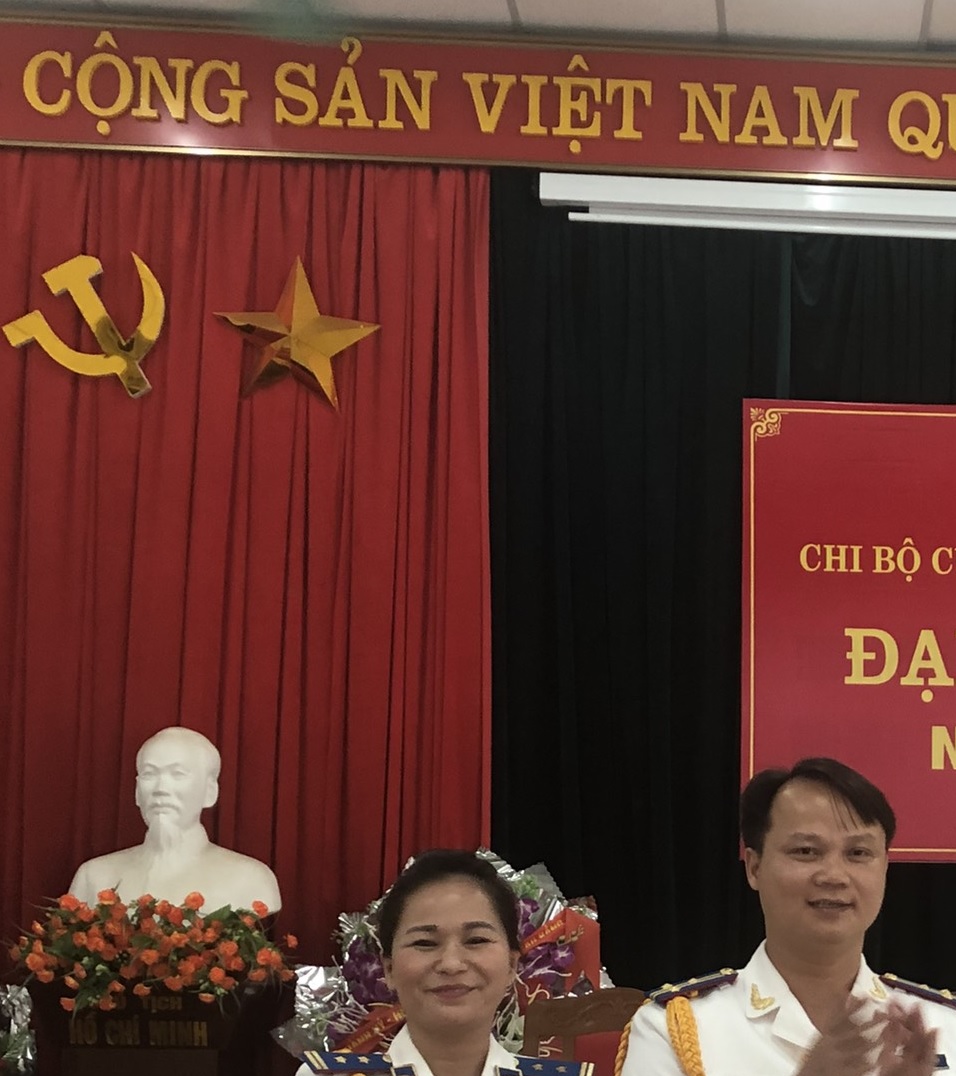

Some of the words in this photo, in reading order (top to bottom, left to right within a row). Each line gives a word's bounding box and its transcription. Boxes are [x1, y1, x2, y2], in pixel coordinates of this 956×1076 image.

[22, 31, 248, 136] CỘNG
[275, 37, 437, 131] SẢN
[463, 54, 652, 153] VIỆT
[679, 83, 859, 149] NAM
[800, 543, 861, 574] CHI
[873, 537, 921, 581] BỘ
